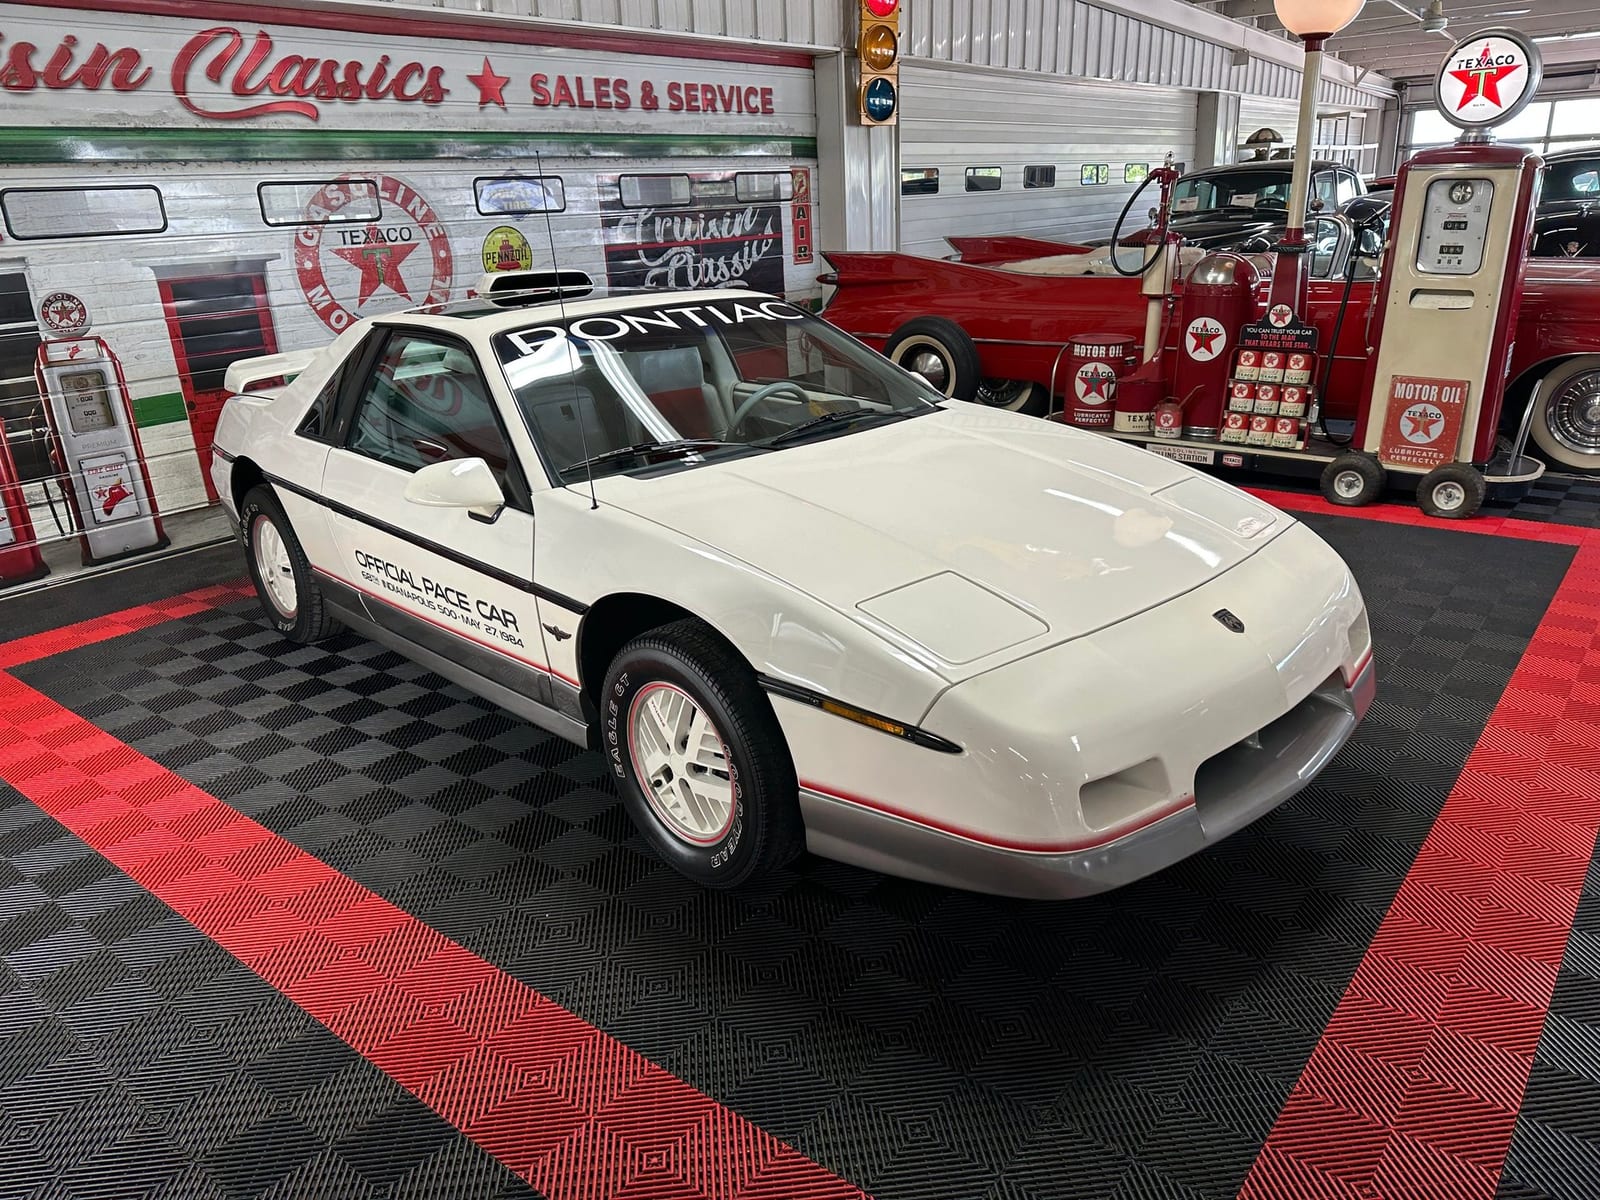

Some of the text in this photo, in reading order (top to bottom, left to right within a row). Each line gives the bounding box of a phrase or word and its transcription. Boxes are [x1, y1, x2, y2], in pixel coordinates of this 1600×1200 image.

[1456, 55, 1515, 69] TEXACO
[0, 27, 450, 121] sin Classics
[530, 73, 775, 114] SALES & SERVICE
[299, 174, 444, 248] GASOLINE
[338, 226, 412, 246] TEXACO
[796, 206, 808, 258] AIR
[485, 247, 529, 265] PENNZOIL
[504, 301, 804, 358] PONTIAC
[1191, 326, 1220, 334] TEXACO
[1073, 344, 1123, 358] MOTOR OIL
[1080, 370, 1113, 378] TEXACO
[1394, 382, 1461, 404] MOTOR OIL
[1073, 411, 1111, 419] LUBRICATES
[1127, 415, 1156, 423] TEXAC
[1407, 410, 1442, 419] TEXACO
[1162, 447, 1197, 455] GASOLINE
[1178, 453, 1208, 463] STATION
[1389, 447, 1445, 459] LUBRICATES
[1390, 454, 1441, 465] PERFECTLY
[355, 550, 520, 633] OFFICIAL PACE CAR
[382, 579, 436, 611] INDIANAPOLIS
[614, 672, 630, 698] GT
[607, 700, 626, 779] EAGLE
[711, 743, 744, 869] GOODYEAR
